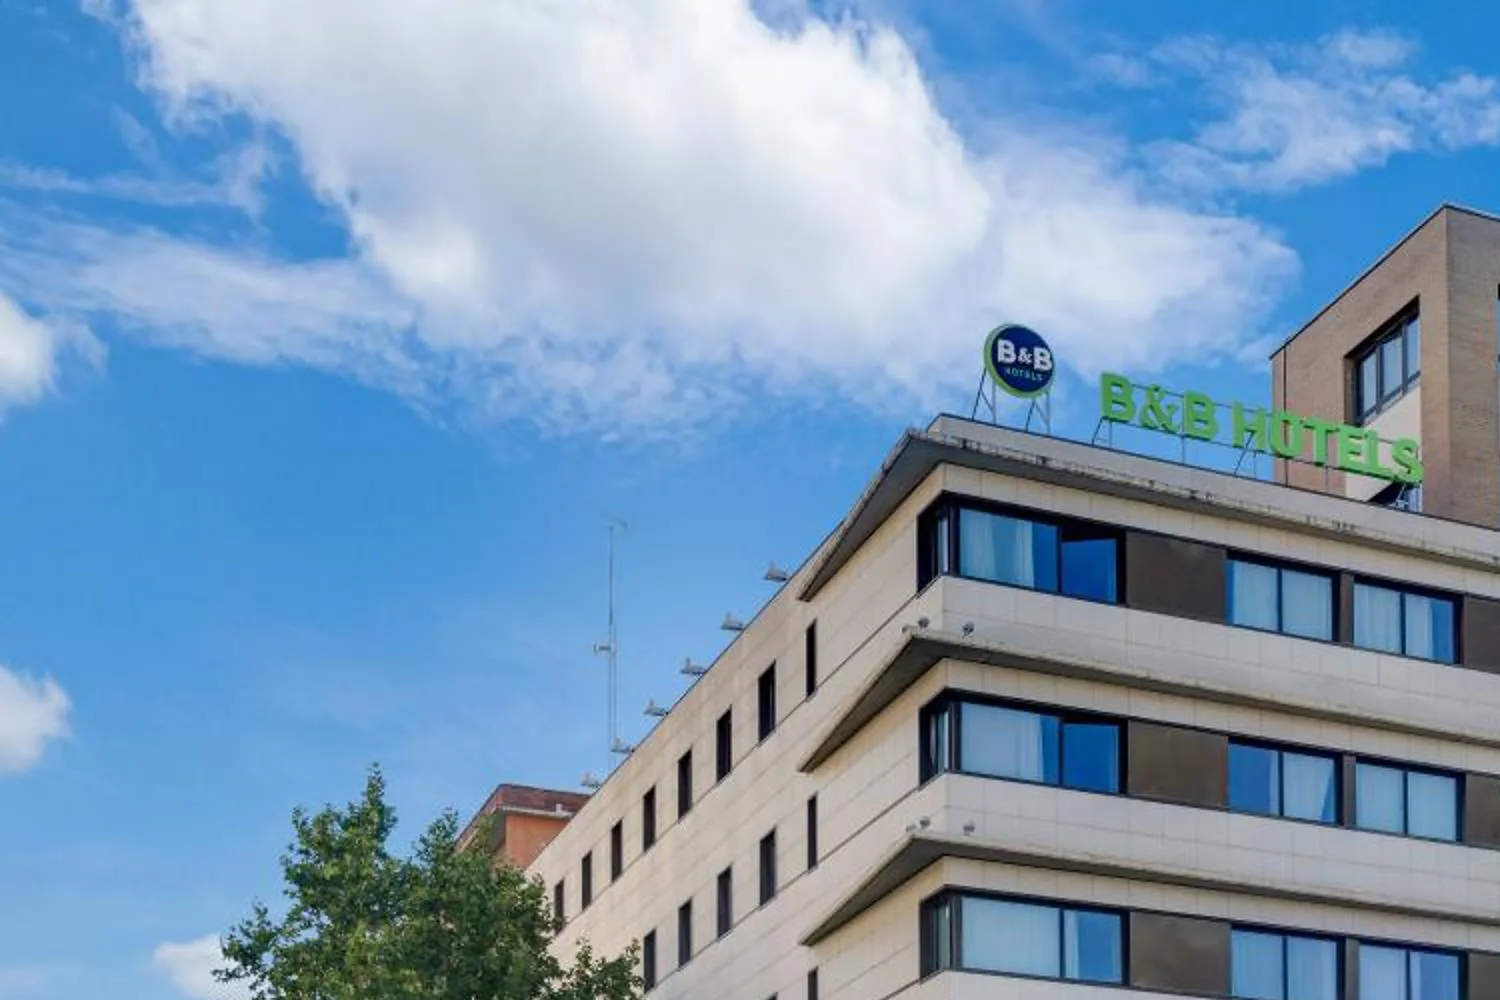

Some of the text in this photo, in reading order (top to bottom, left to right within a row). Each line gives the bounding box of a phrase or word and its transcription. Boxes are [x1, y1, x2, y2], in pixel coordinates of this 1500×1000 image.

[997, 339, 1053, 371] B&B
[1101, 372, 1424, 484] B&B HOTELS
